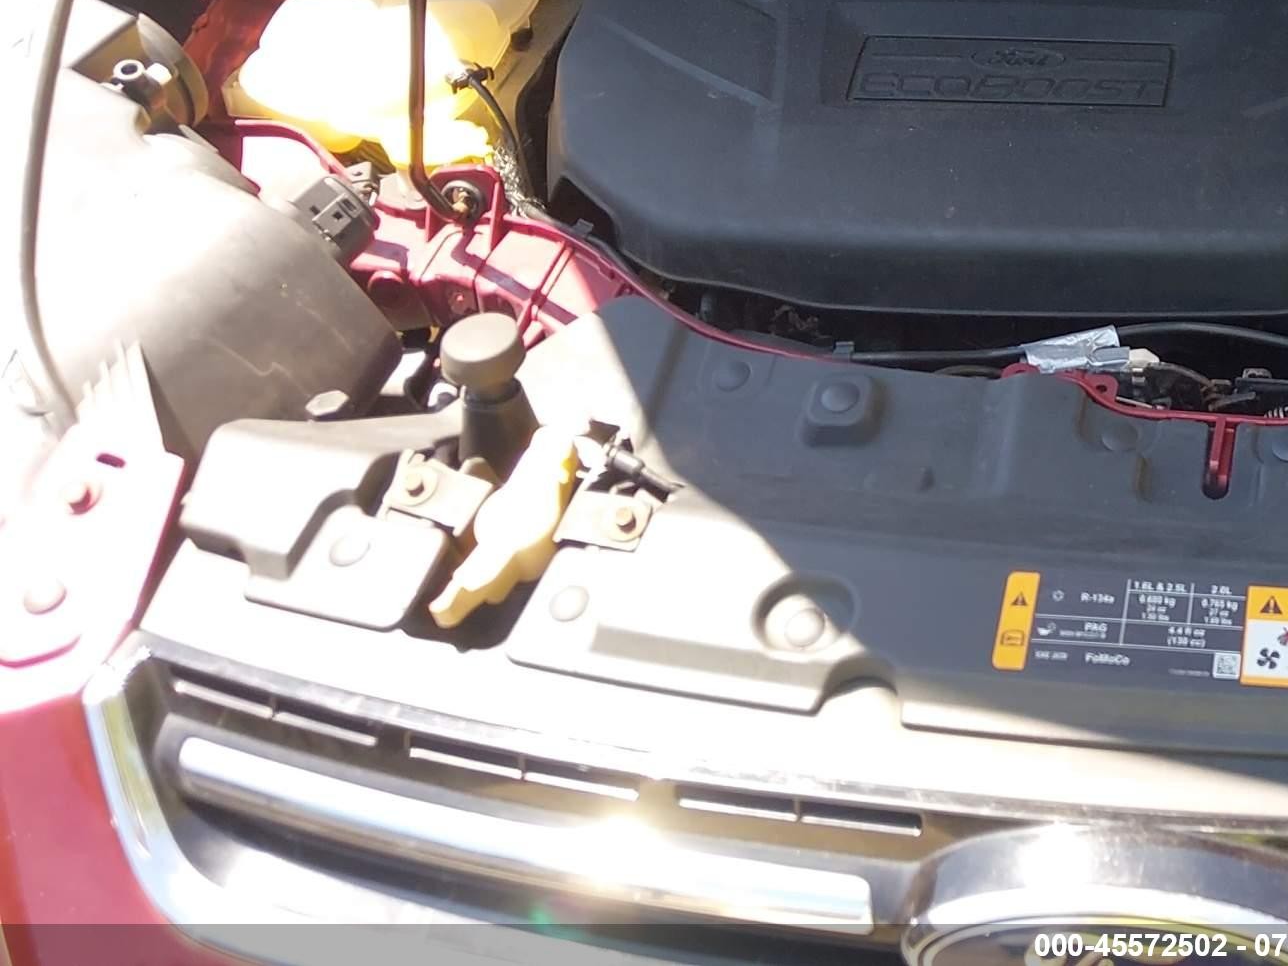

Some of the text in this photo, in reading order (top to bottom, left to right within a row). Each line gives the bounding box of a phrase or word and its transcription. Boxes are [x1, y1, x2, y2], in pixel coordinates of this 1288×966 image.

[861, 73, 1167, 100] ECOBOOST
[1080, 591, 1115, 605] R-134a
[1164, 596, 1176, 608] kg
[1226, 600, 1239, 612] kg
[1084, 652, 1131, 666] FoMoCo
